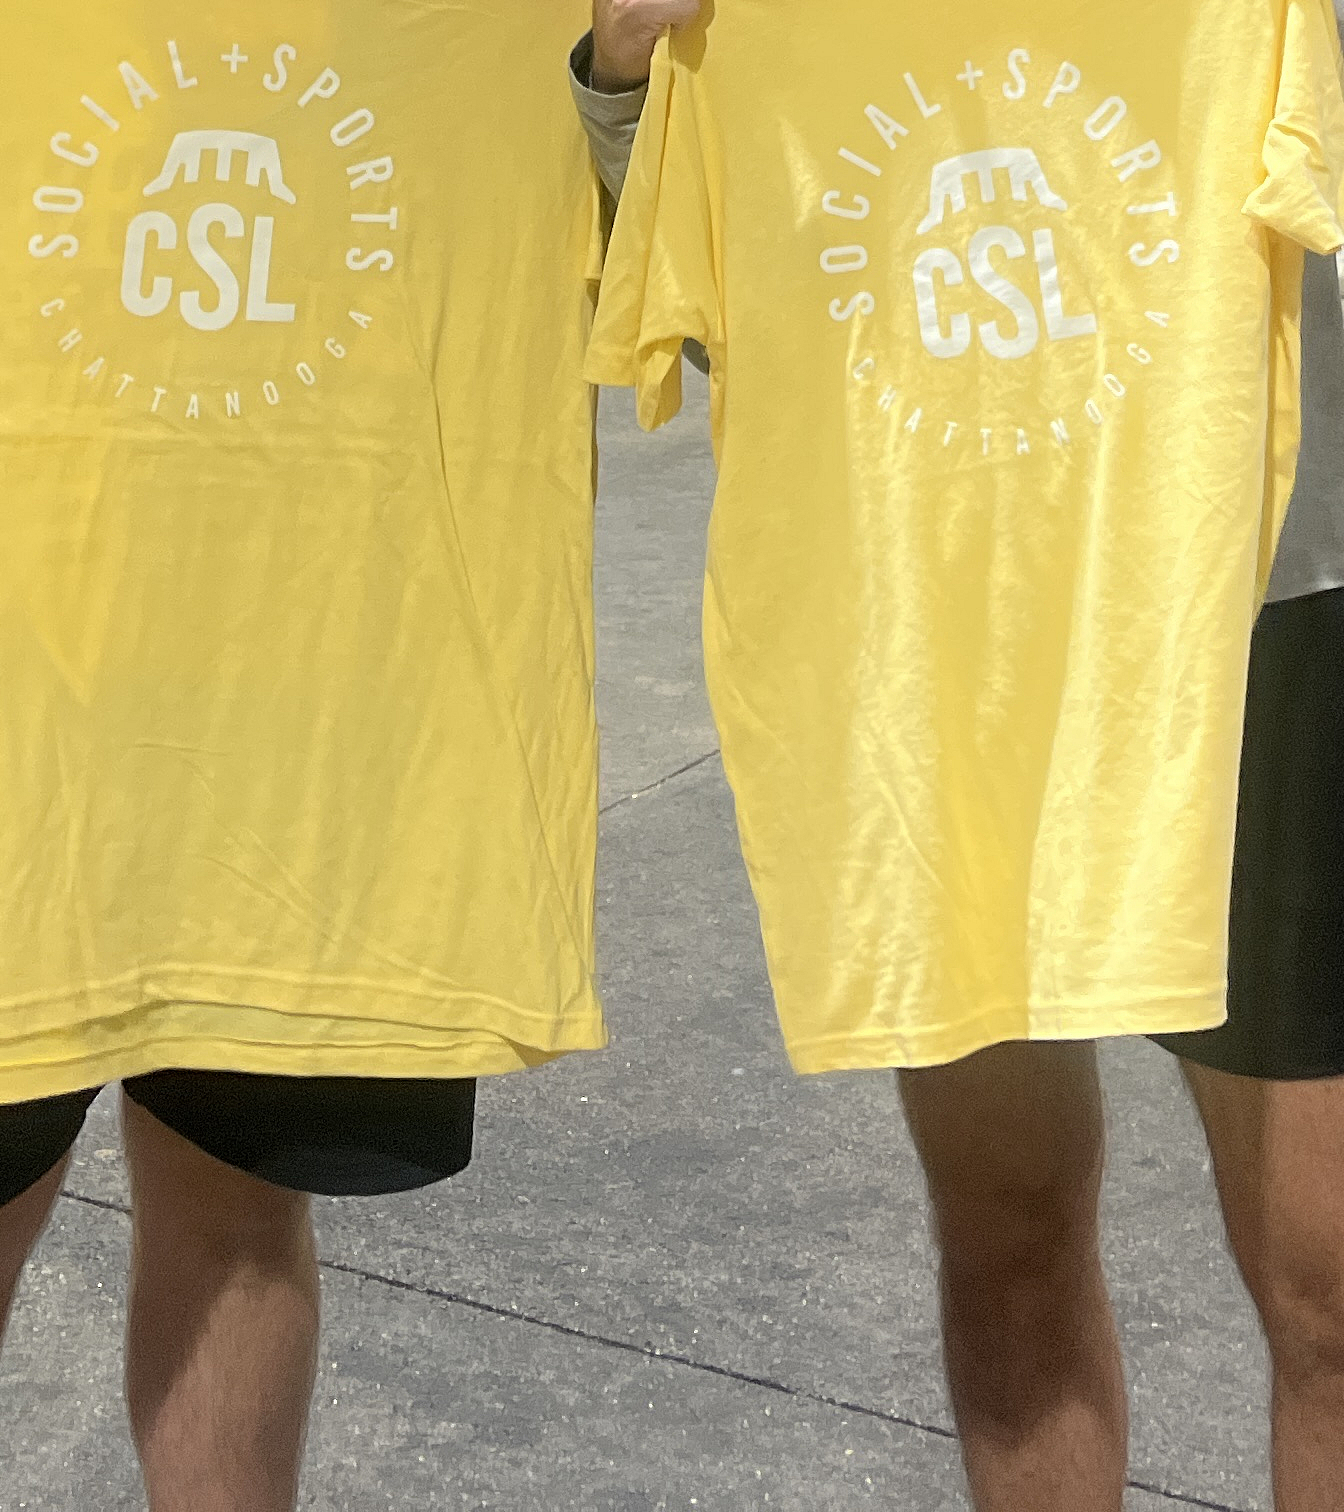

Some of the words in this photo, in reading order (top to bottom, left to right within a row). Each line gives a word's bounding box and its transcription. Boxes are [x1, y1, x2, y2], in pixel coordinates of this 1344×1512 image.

[120, 202, 297, 331] CSL
[912, 225, 1097, 360] CSL
[40, 296, 373, 419] CHATTANOOGA
[852, 308, 1171, 455] CHATTANOOGA
